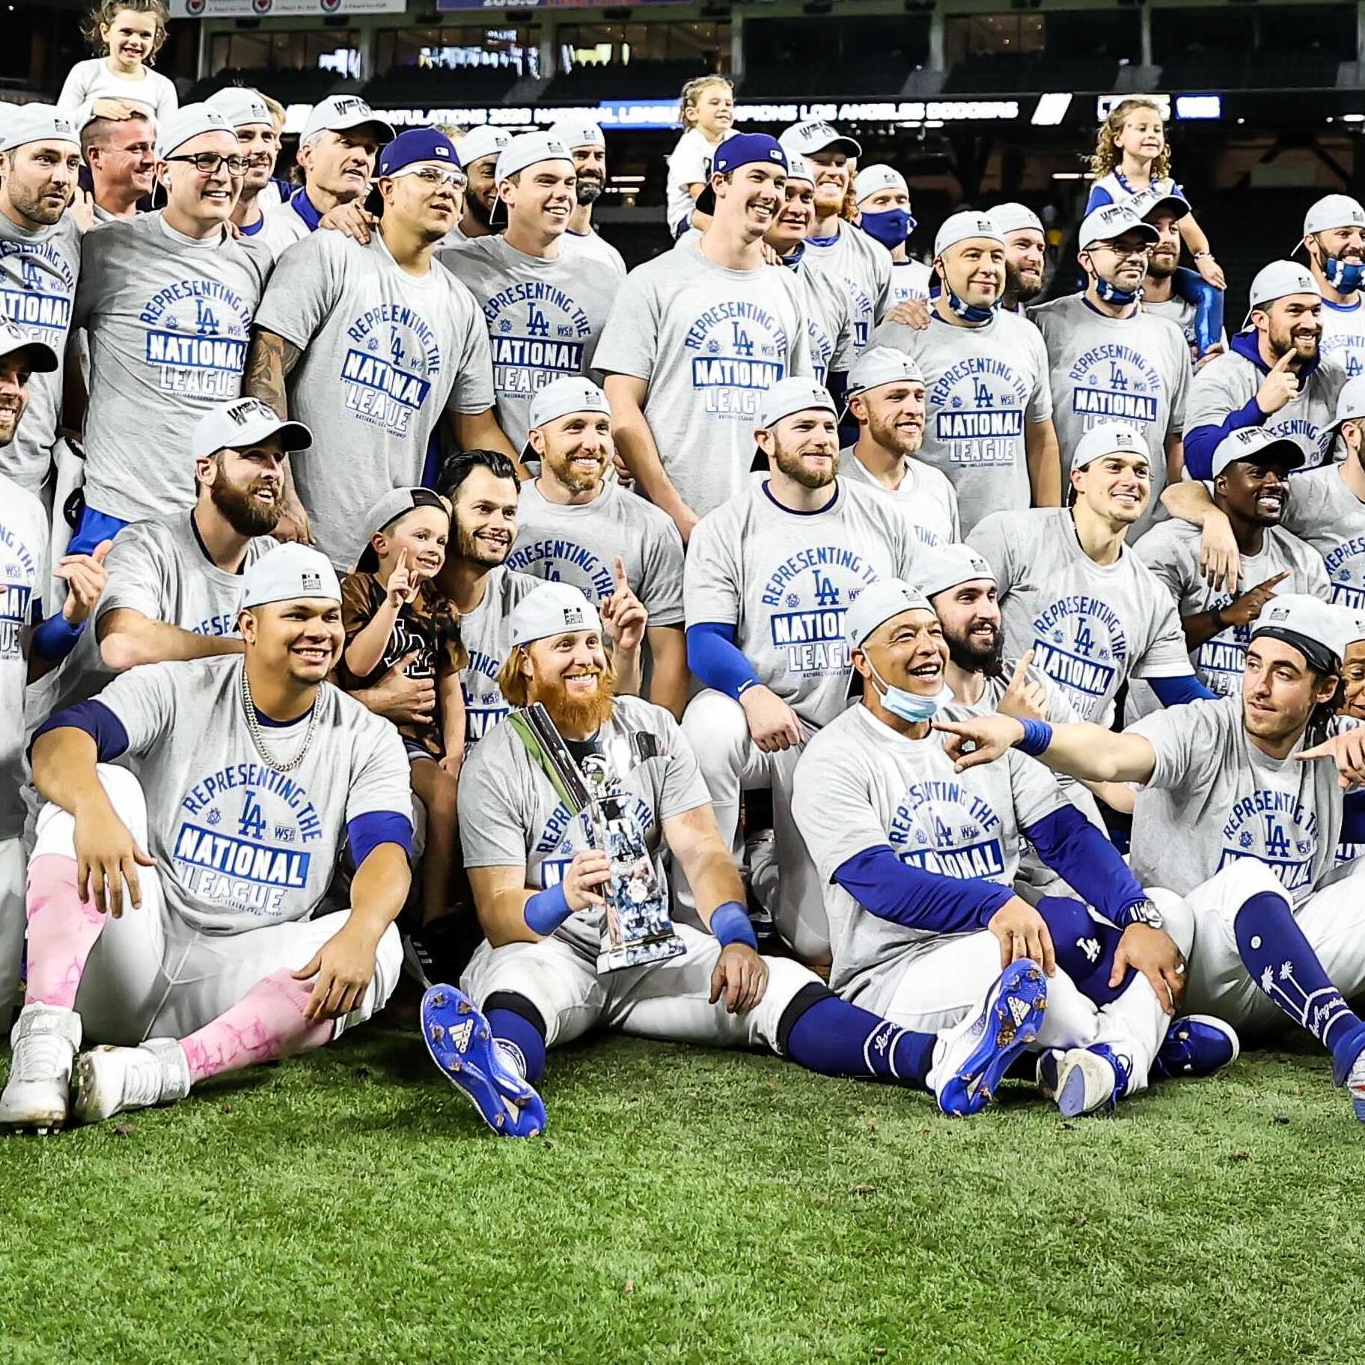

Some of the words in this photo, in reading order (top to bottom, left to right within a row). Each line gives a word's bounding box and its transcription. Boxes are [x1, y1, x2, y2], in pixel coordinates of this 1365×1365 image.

[139, 280, 243, 326] REPRESENTING
[194, 298, 220, 335] LA
[526, 301, 552, 337] LA
[571, 301, 592, 337] THE
[685, 301, 774, 350] REPRESENTING
[772, 325, 787, 358] THE
[731, 321, 754, 357] LA
[148, 334, 243, 372] NATIONAL
[427, 343, 441, 375] THE
[1069, 344, 1147, 381] REPRESENTING
[1344, 349, 1364, 377] LA
[159, 363, 236, 397] LEAGUE
[930, 357, 1013, 407] REPRESENTING
[973, 376, 995, 408] LA
[1110, 361, 1128, 391] LA
[1074, 389, 1156, 420] NATIONAL
[938, 412, 1021, 436] NATIONAL
[949, 438, 1015, 462] LEAGUE
[15, 545, 36, 577] THE
[506, 539, 594, 573] PRESENTING
[594, 568, 616, 601] THE
[762, 546, 862, 607] REPRESENTING
[811, 569, 840, 606] LA
[1034, 596, 1115, 634] REPRESENTING
[1111, 633, 1127, 661] THE
[1074, 617, 1095, 657] LA
[1031, 639, 1109, 694] NATIONAL
[182, 763, 306, 816] REPRESENTING
[295, 801, 324, 844] THE
[237, 789, 268, 841] LA
[635, 797, 655, 831] THE
[969, 795, 1001, 833] THE
[1264, 813, 1292, 858] LA
[176, 826, 304, 885] NATIONAL
[182, 865, 287, 913] LEAGUE
[1075, 936, 1102, 964] LA
